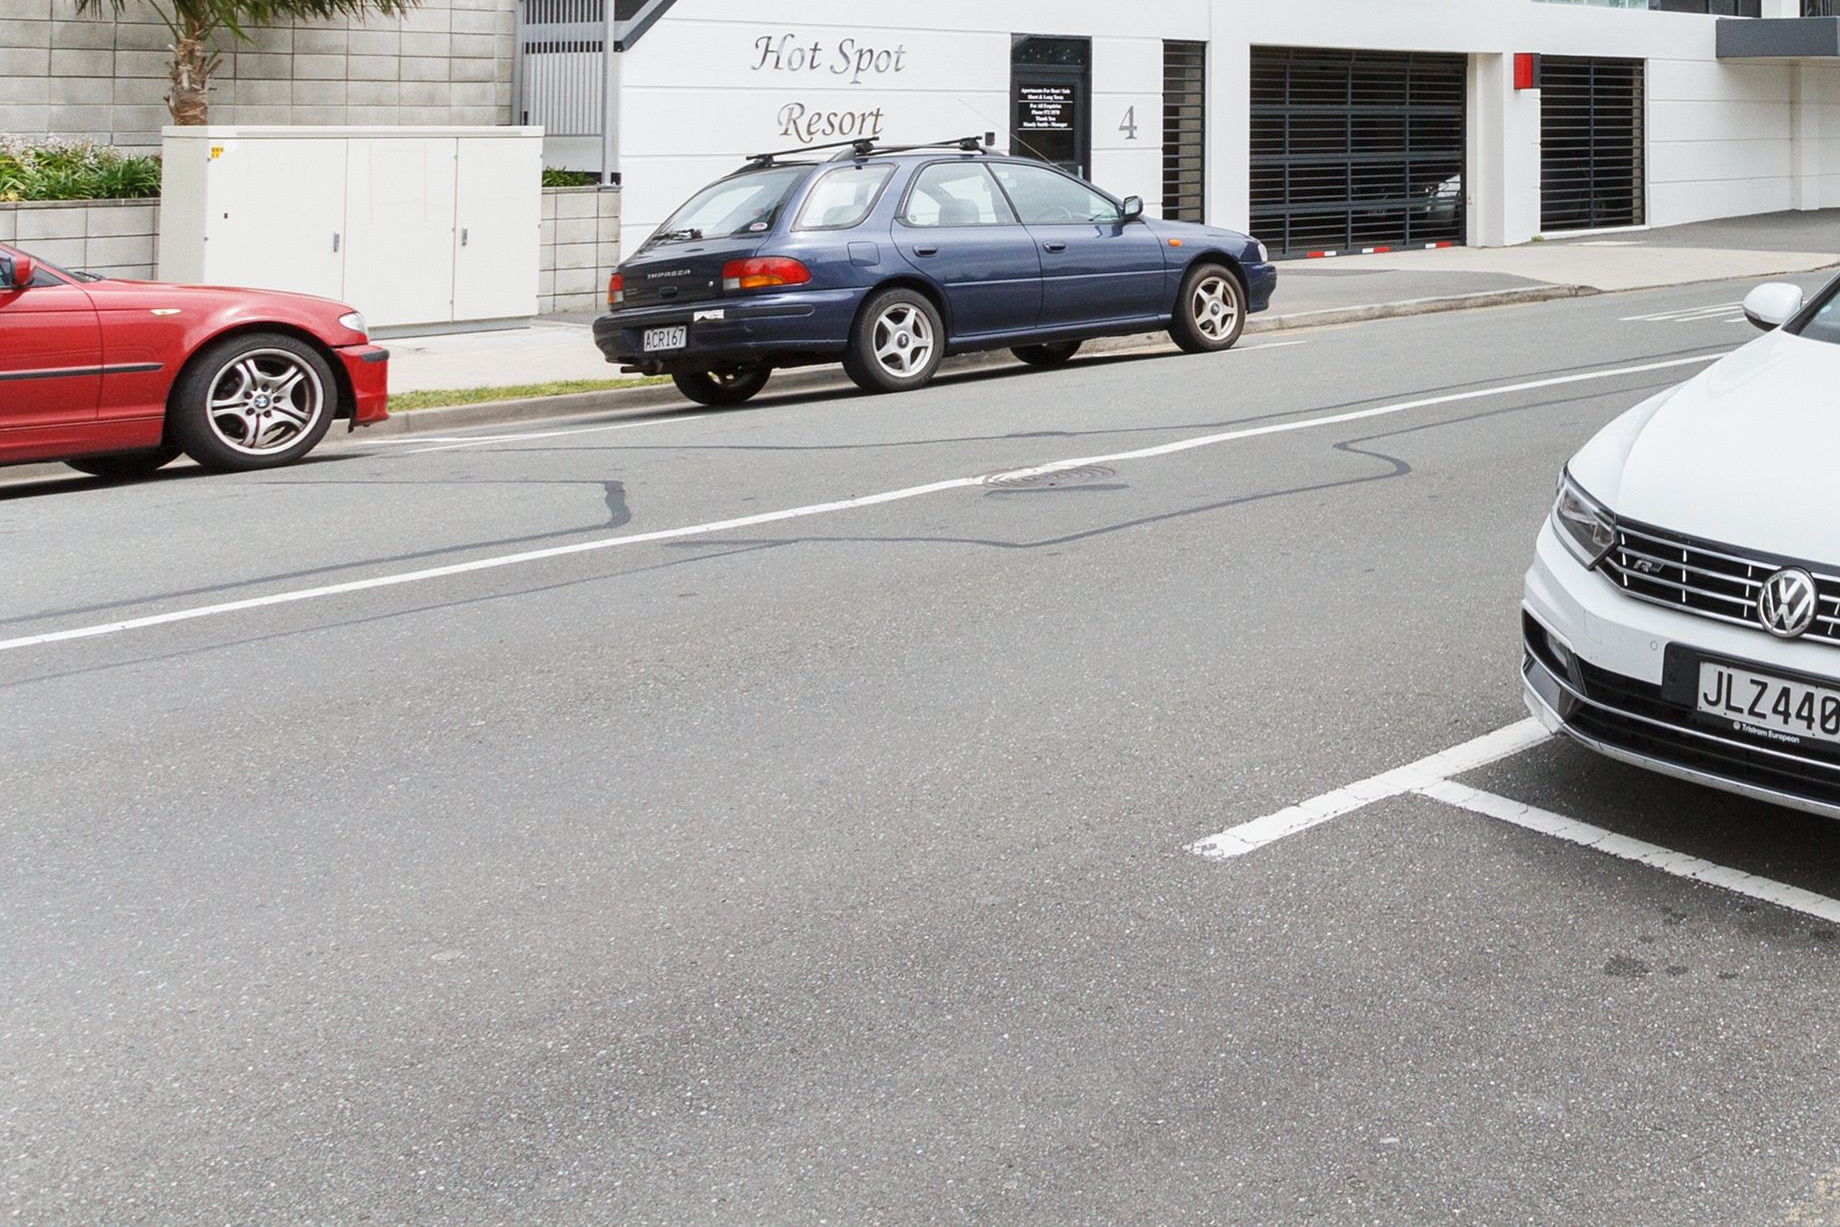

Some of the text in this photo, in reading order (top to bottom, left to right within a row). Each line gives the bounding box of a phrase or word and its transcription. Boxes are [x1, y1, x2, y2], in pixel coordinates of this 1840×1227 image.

[751, 33, 906, 84] Hot Spot
[777, 102, 884, 144] Resort
[1118, 105, 1138, 140] 4
[645, 329, 684, 349] ACR167
[1768, 730, 1800, 744] European
